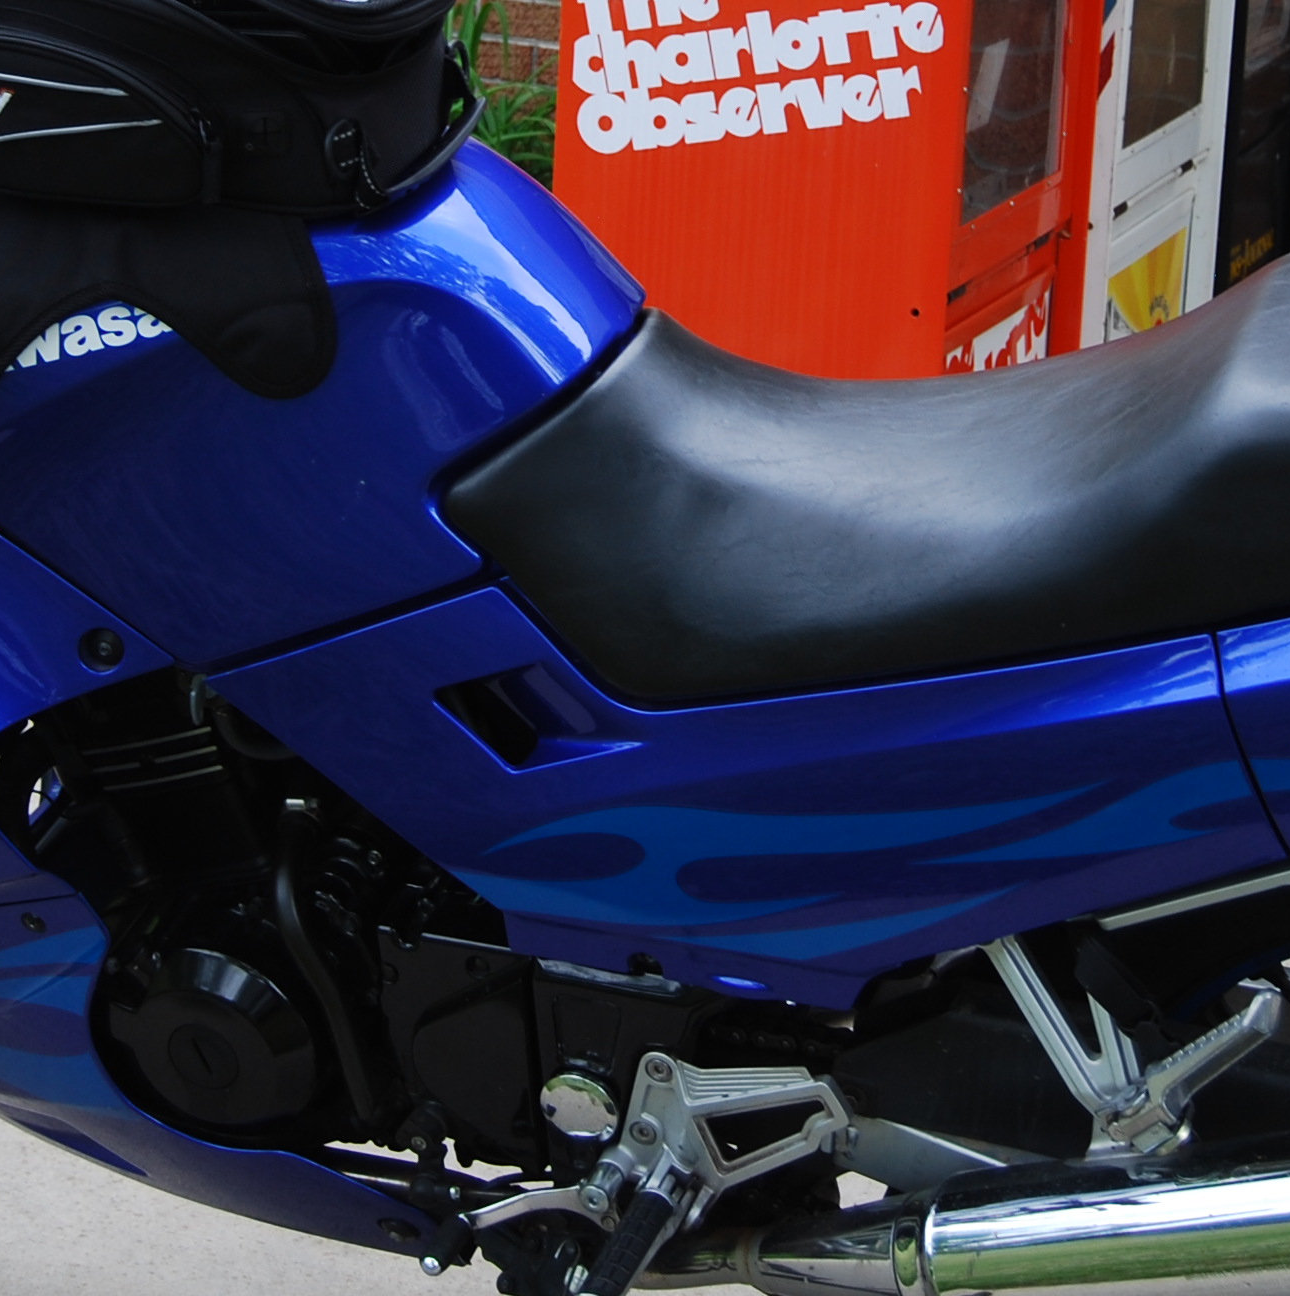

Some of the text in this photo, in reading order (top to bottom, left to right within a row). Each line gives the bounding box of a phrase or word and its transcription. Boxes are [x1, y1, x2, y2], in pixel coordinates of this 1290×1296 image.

[572, 2, 944, 95] Charlotte
[576, 65, 921, 154] Observer
[5, 305, 173, 371] wasa
